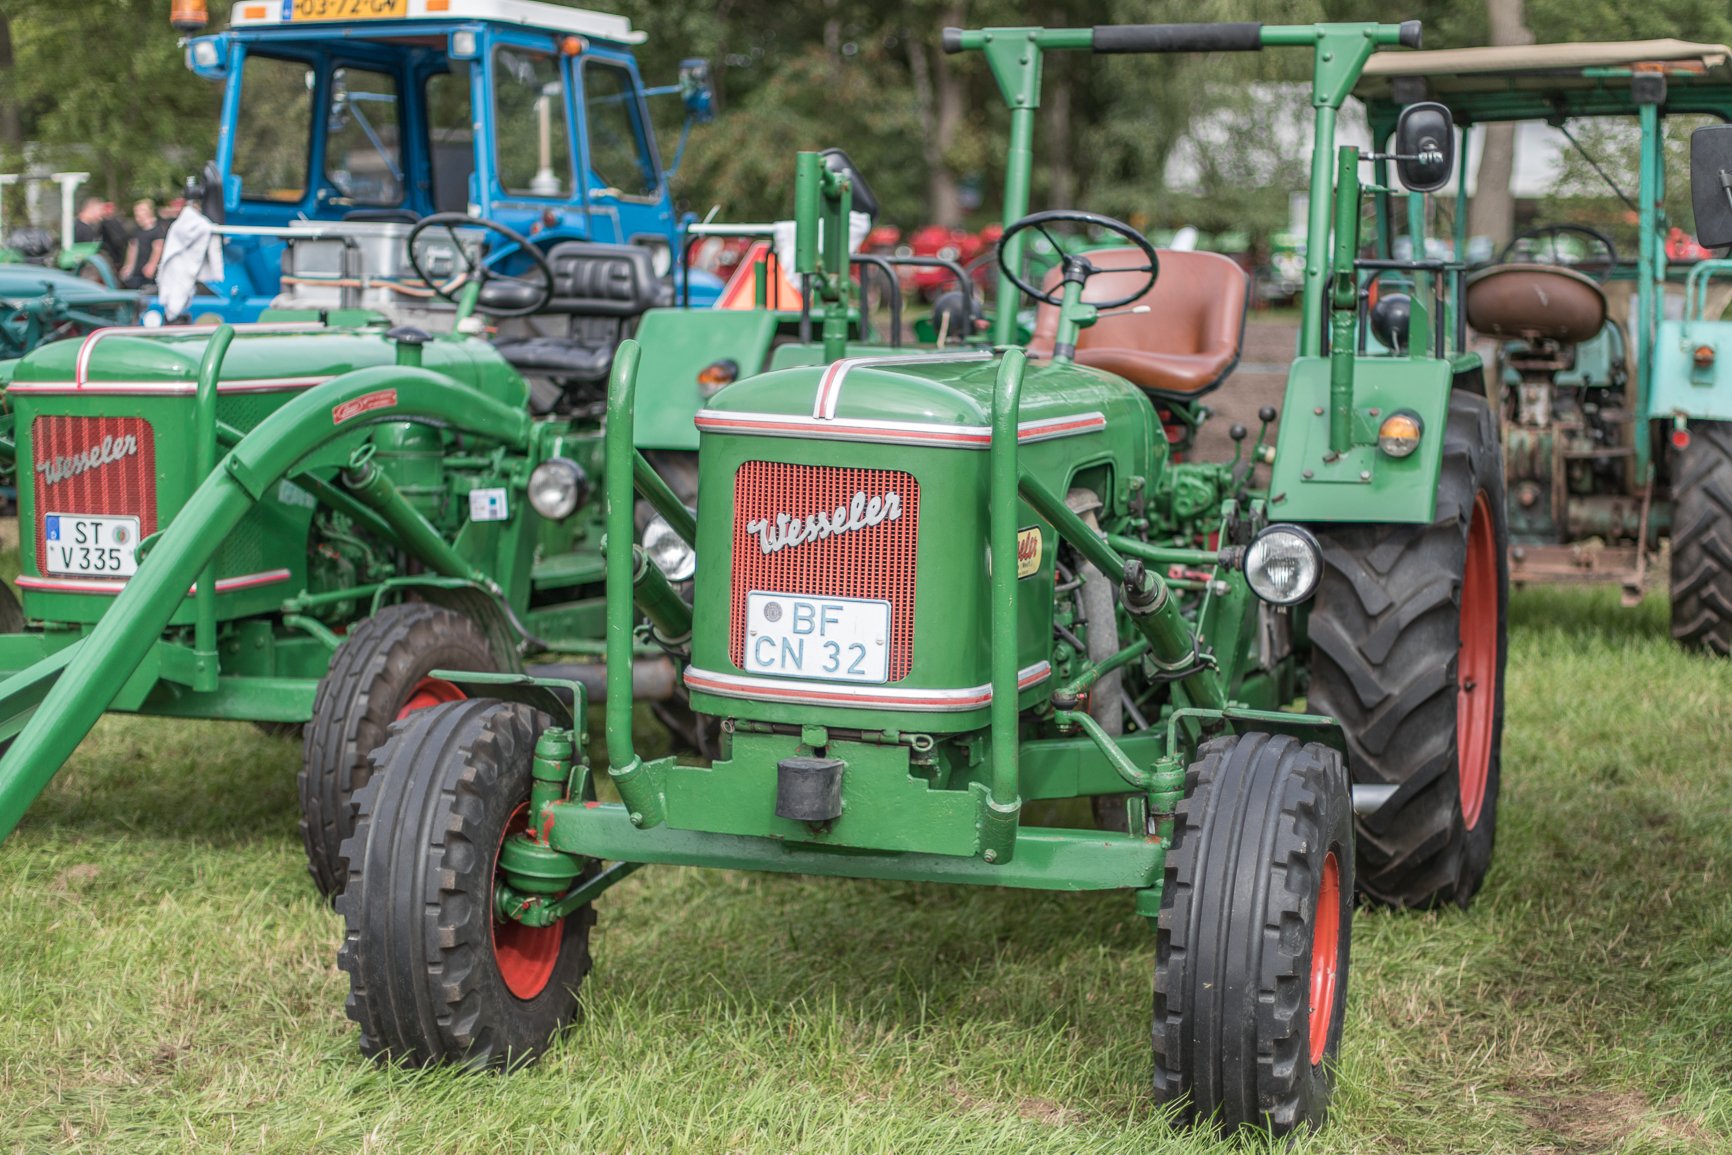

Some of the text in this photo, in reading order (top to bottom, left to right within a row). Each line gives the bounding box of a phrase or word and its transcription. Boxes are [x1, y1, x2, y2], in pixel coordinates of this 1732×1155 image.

[36, 434, 137, 485] Wesseler
[75, 521, 103, 544] ST
[747, 491, 902, 555] Wesseler
[61, 546, 121, 571] V 335
[793, 602, 844, 637] BF
[755, 635, 867, 675] CN 32
